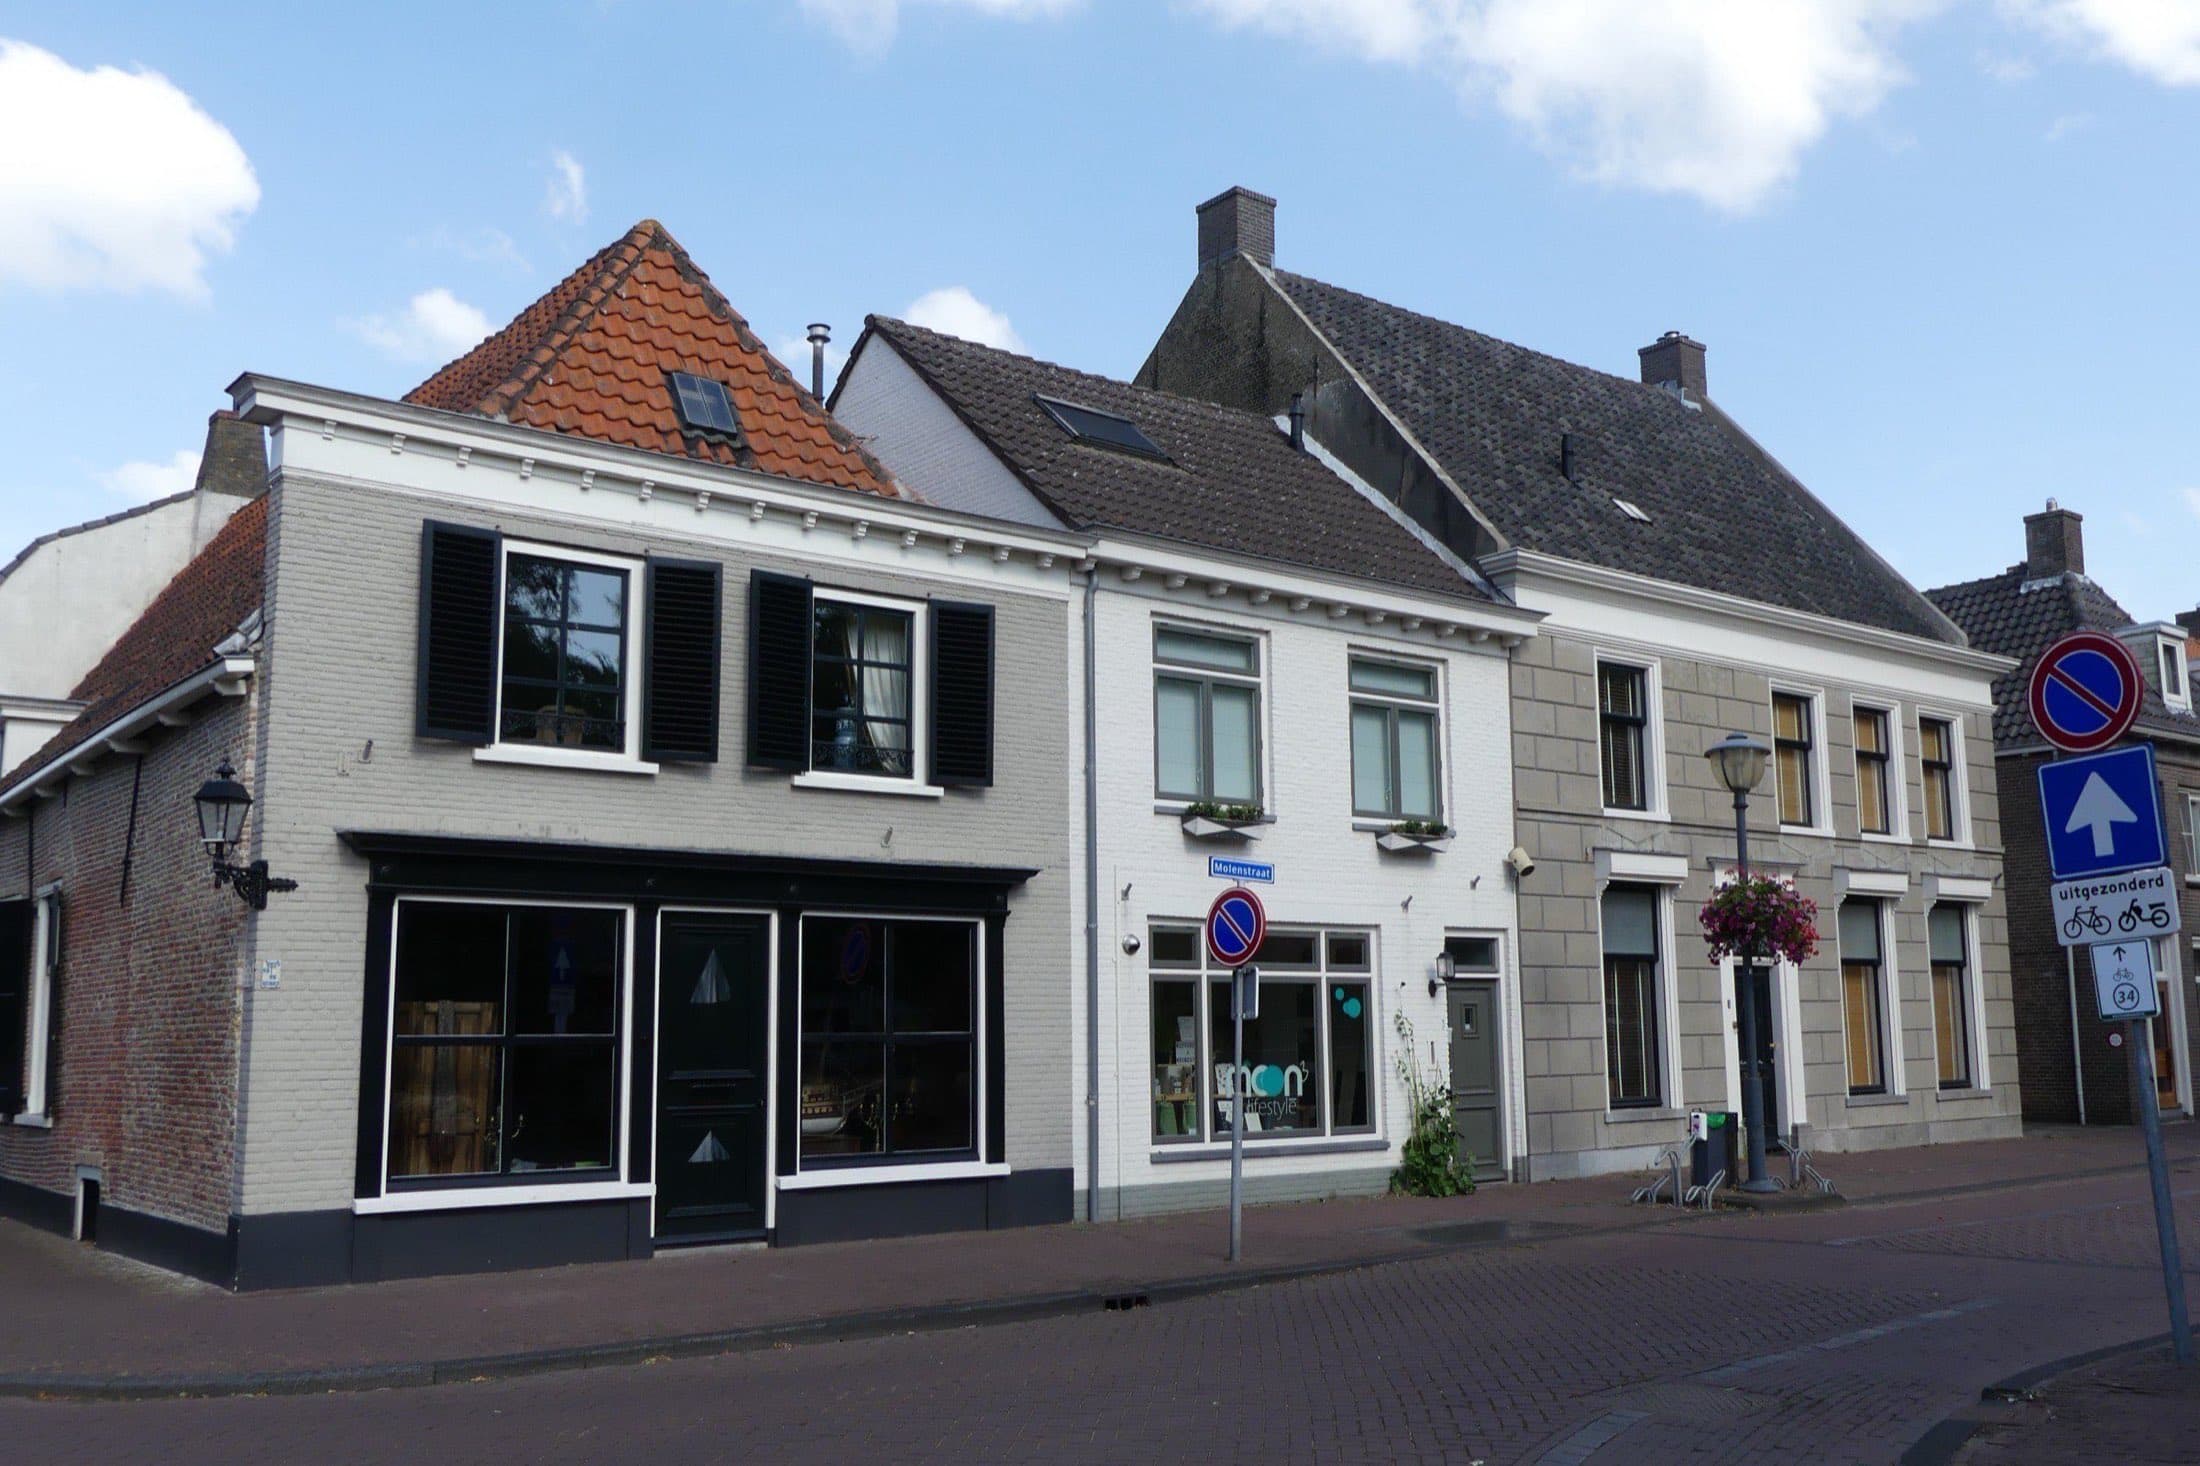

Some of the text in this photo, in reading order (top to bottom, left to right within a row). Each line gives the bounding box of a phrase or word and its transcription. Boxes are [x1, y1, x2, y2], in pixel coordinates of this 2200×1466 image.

[1214, 861, 1271, 879] Molenstraat
[2060, 873, 2164, 901] uitgezonderd
[2117, 990, 2135, 1004] 34
[1247, 1097, 1297, 1121] lifestyle
